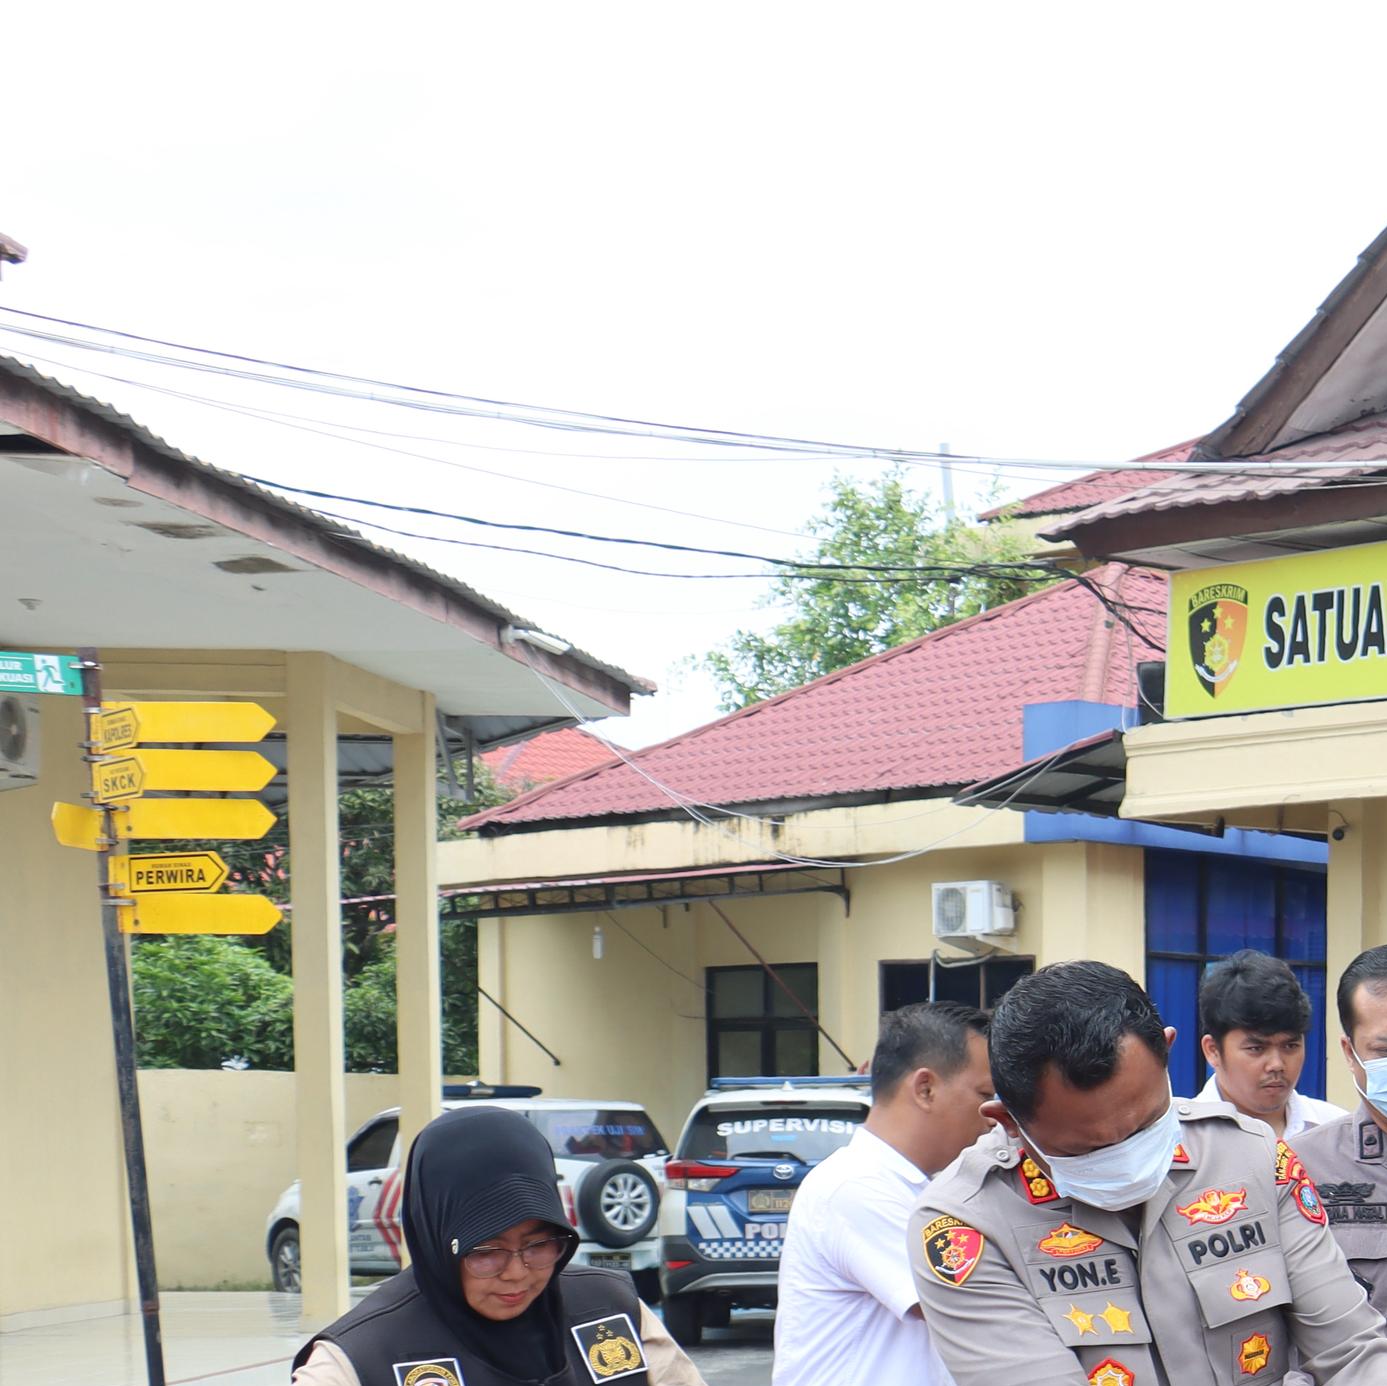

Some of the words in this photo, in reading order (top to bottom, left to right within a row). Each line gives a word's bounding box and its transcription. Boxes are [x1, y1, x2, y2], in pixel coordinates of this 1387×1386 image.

[1190, 584, 1247, 606] BARESKRIM
[103, 773, 136, 793] SKCK
[135, 868, 206, 885] PERWIRA
[1187, 1220, 1267, 1265] POLRI
[1039, 1257, 1121, 1292] YON.E
